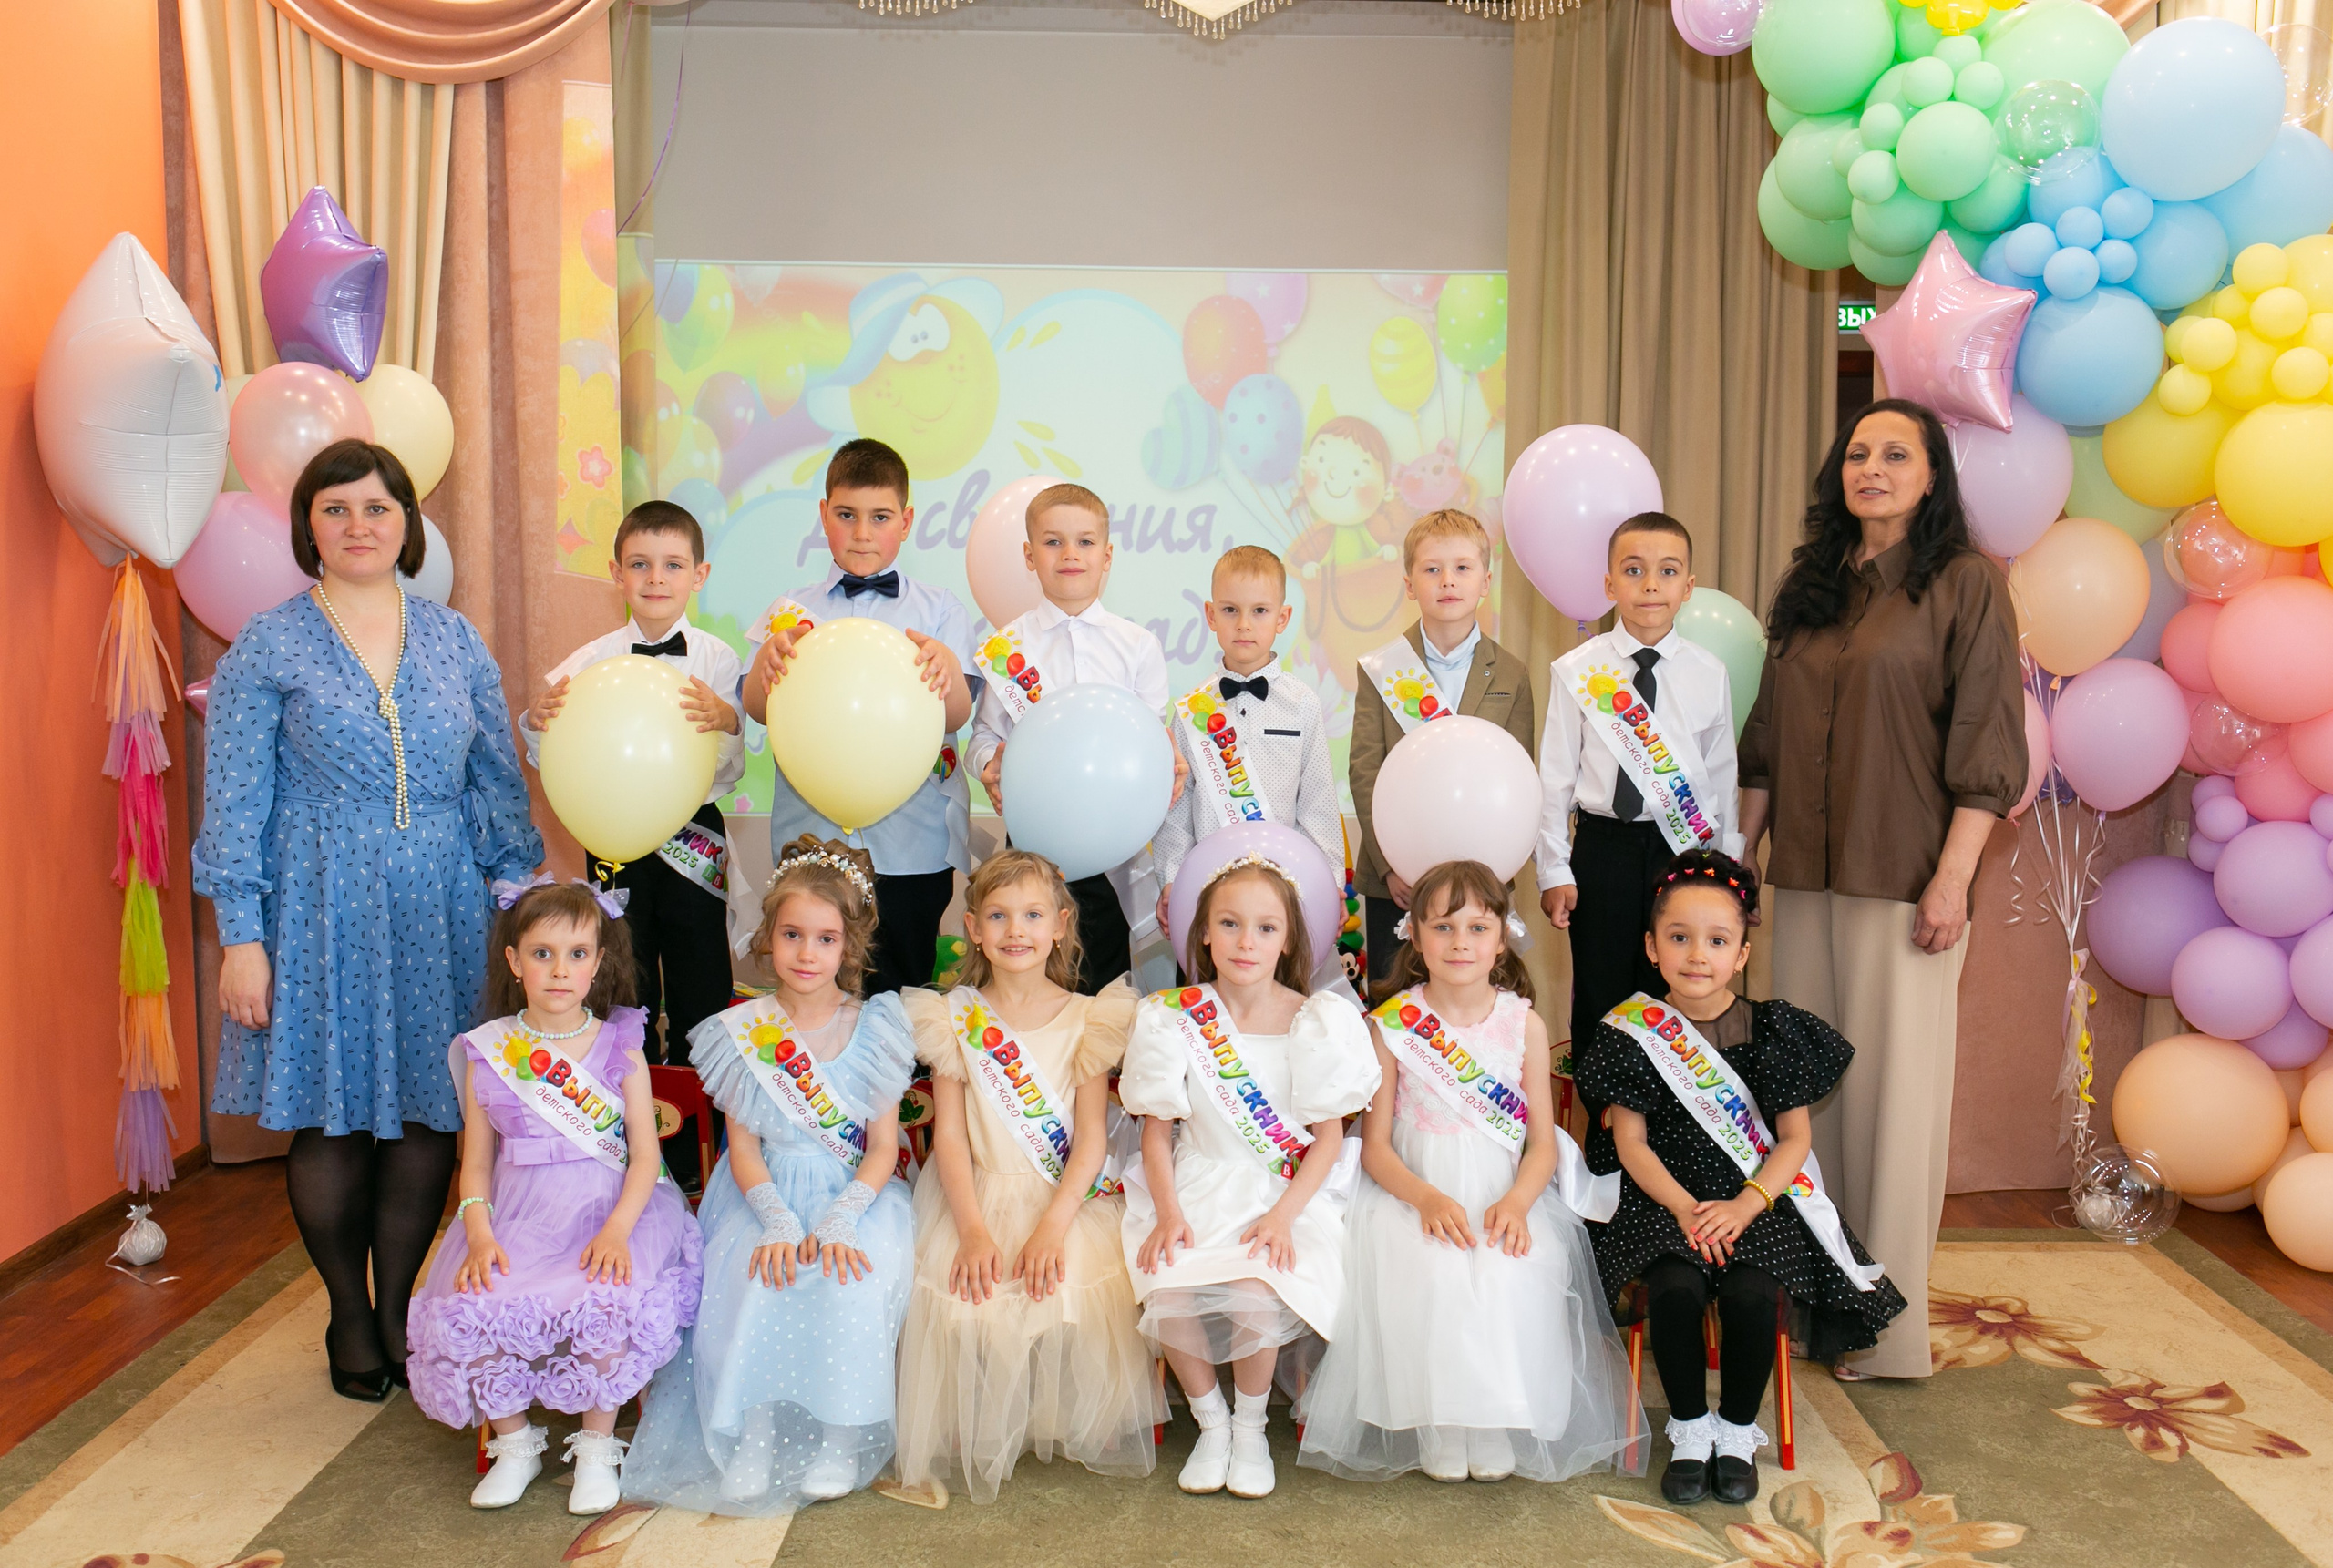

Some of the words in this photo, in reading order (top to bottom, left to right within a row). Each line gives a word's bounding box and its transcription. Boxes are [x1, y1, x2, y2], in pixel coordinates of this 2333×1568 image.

[1200, 740, 1228, 795] детского
[1224, 803, 1241, 825] сад
[1611, 722, 1651, 774] детского
[1651, 781, 1670, 809] сада
[1666, 808, 1691, 844] 2025
[662, 841, 699, 868] 2025
[536, 1085, 592, 1136] детского
[596, 1139, 621, 1157] сада
[546, 1058, 626, 1140] Выпус
[772, 1072, 817, 1129] детского
[820, 1134, 848, 1158] сада
[847, 1151, 863, 1168] 20
[979, 1059, 1021, 1118] детского
[1021, 1123, 1045, 1153] сада
[1040, 1152, 1062, 1183] 202
[993, 1040, 1071, 1168] Выпускн
[1177, 1017, 1216, 1079] детского
[1216, 1084, 1239, 1115] сада
[1235, 1115, 1270, 1154] 2025
[1190, 1000, 1305, 1157] Выпускник
[1403, 1037, 1456, 1087] детского
[1459, 1090, 1487, 1114] сада
[1486, 1110, 1522, 1141] 2025
[1415, 1013, 1528, 1125] Выпускни
[1646, 1035, 1693, 1091] детского
[1695, 1095, 1721, 1124] сада
[1718, 1123, 1753, 1160] 2025
